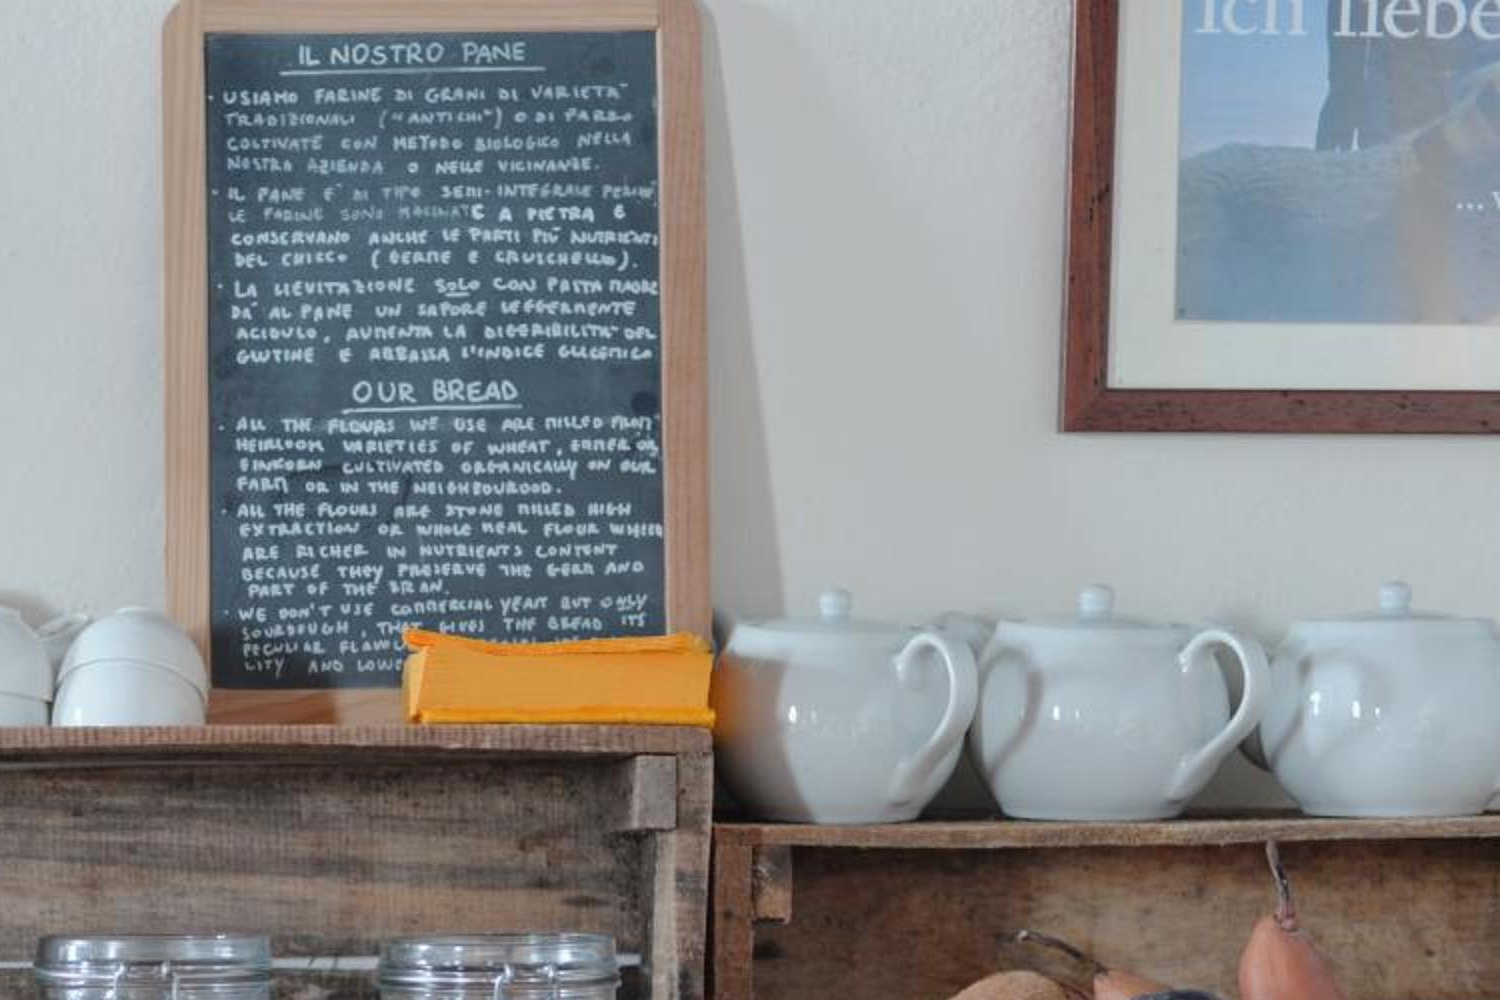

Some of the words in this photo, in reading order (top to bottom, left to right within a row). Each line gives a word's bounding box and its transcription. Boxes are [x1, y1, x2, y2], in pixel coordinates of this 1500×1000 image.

[299, 45, 320, 65] IL
[330, 42, 444, 65] NOSTRO
[461, 42, 526, 64] PANE
[223, 90, 298, 106] USIAMO
[314, 87, 382, 102] FARINE
[394, 89, 413, 101] DI
[425, 87, 485, 103] GRANI
[498, 88, 518, 101] DI
[227, 135, 324, 151] COLTIVATE
[340, 135, 377, 150] CON
[393, 134, 463, 150] METODO
[475, 136, 560, 152] BIOLOGICO
[577, 131, 632, 147] NELLA
[227, 155, 292, 172] NOSTRA
[435, 159, 485, 175] NELLE
[257, 187, 305, 203] PANE
[263, 207, 324, 223] FARINE
[499, 207, 513, 222] A
[526, 205, 595, 223] PIETRA
[230, 230, 350, 246] CONSERVANO
[368, 230, 428, 245] ANCHE
[442, 227, 461, 243] LE
[234, 253, 269, 269] DEL
[234, 280, 258, 299] LA
[274, 277, 416, 296] LIEVITAZIONE
[434, 278, 481, 294] SOLO
[492, 277, 537, 293] CON
[547, 276, 602, 294] PASTA
[269, 305, 293, 320] AL
[301, 303, 353, 322] PANE
[375, 303, 403, 318] UN
[417, 301, 487, 318] SAPORE
[345, 323, 433, 342] AUMENTA
[443, 324, 468, 340] LA
[623, 325, 658, 341] DEL
[236, 346, 315, 364] GLUTINE
[339, 347, 353, 363] E
[369, 345, 450, 363] ABBASSA
[353, 379, 417, 403] OUR
[432, 377, 519, 402] BREAD
[236, 416, 267, 432] ALL
[282, 417, 313, 433] THE
[327, 418, 396, 436] FLOURS
[409, 416, 439, 432] WE
[454, 417, 487, 432] USE
[502, 417, 536, 432] ARE
[545, 416, 603, 430] MILLED
[236, 438, 325, 453] HEIRLOOM
[342, 439, 439, 453] VARIETIES
[451, 441, 475, 454] OF
[240, 457, 322, 473] EINKORN
[342, 459, 444, 475] CULTIVATED
[461, 459, 578, 480] ORGANICALLY
[587, 458, 612, 472] ON
[619, 459, 656, 474] OUR
[236, 476, 288, 493] FARM
[305, 481, 330, 494] OR
[340, 481, 359, 494] IN
[368, 480, 399, 494] THE
[237, 503, 265, 518] ALL
[273, 503, 304, 517] THE
[317, 502, 377, 517] FLOURS
[394, 505, 431, 519] ARE
[446, 504, 503, 518] STONE
[517, 503, 576, 517] MILLED
[587, 502, 632, 516] HIGH
[240, 523, 360, 537] EXTRACTION
[378, 524, 404, 536] OR
[416, 524, 473, 537] WHOLE
[481, 522, 529, 536] MEAL
[544, 523, 600, 538] FLOUR
[243, 546, 280, 562] ARE
[296, 543, 369, 559] RICHER
[387, 546, 406, 559] IN
[419, 543, 523, 559] NUTRIENTS
[535, 543, 618, 557] CONTENT
[241, 564, 320, 581] BECAUSE
[338, 564, 384, 584] THEY
[398, 563, 487, 578] PRESERVE
[500, 564, 532, 579] THE
[604, 561, 645, 575] AND
[248, 583, 295, 598] PART
[307, 582, 330, 596] OF
[342, 583, 376, 597] THE
[238, 606, 267, 622] WE
[278, 602, 332, 620] DON'T
[340, 603, 374, 617] USE
[391, 599, 492, 617] COMMERCIAL
[560, 599, 591, 610] BUT
[601, 594, 648, 611] ONLY
[503, 618, 536, 631] THE
[547, 618, 603, 632] BREAD
[620, 612, 646, 627] ITS
[243, 642, 325, 657] PECULIAR
[308, 661, 345, 673] AND
